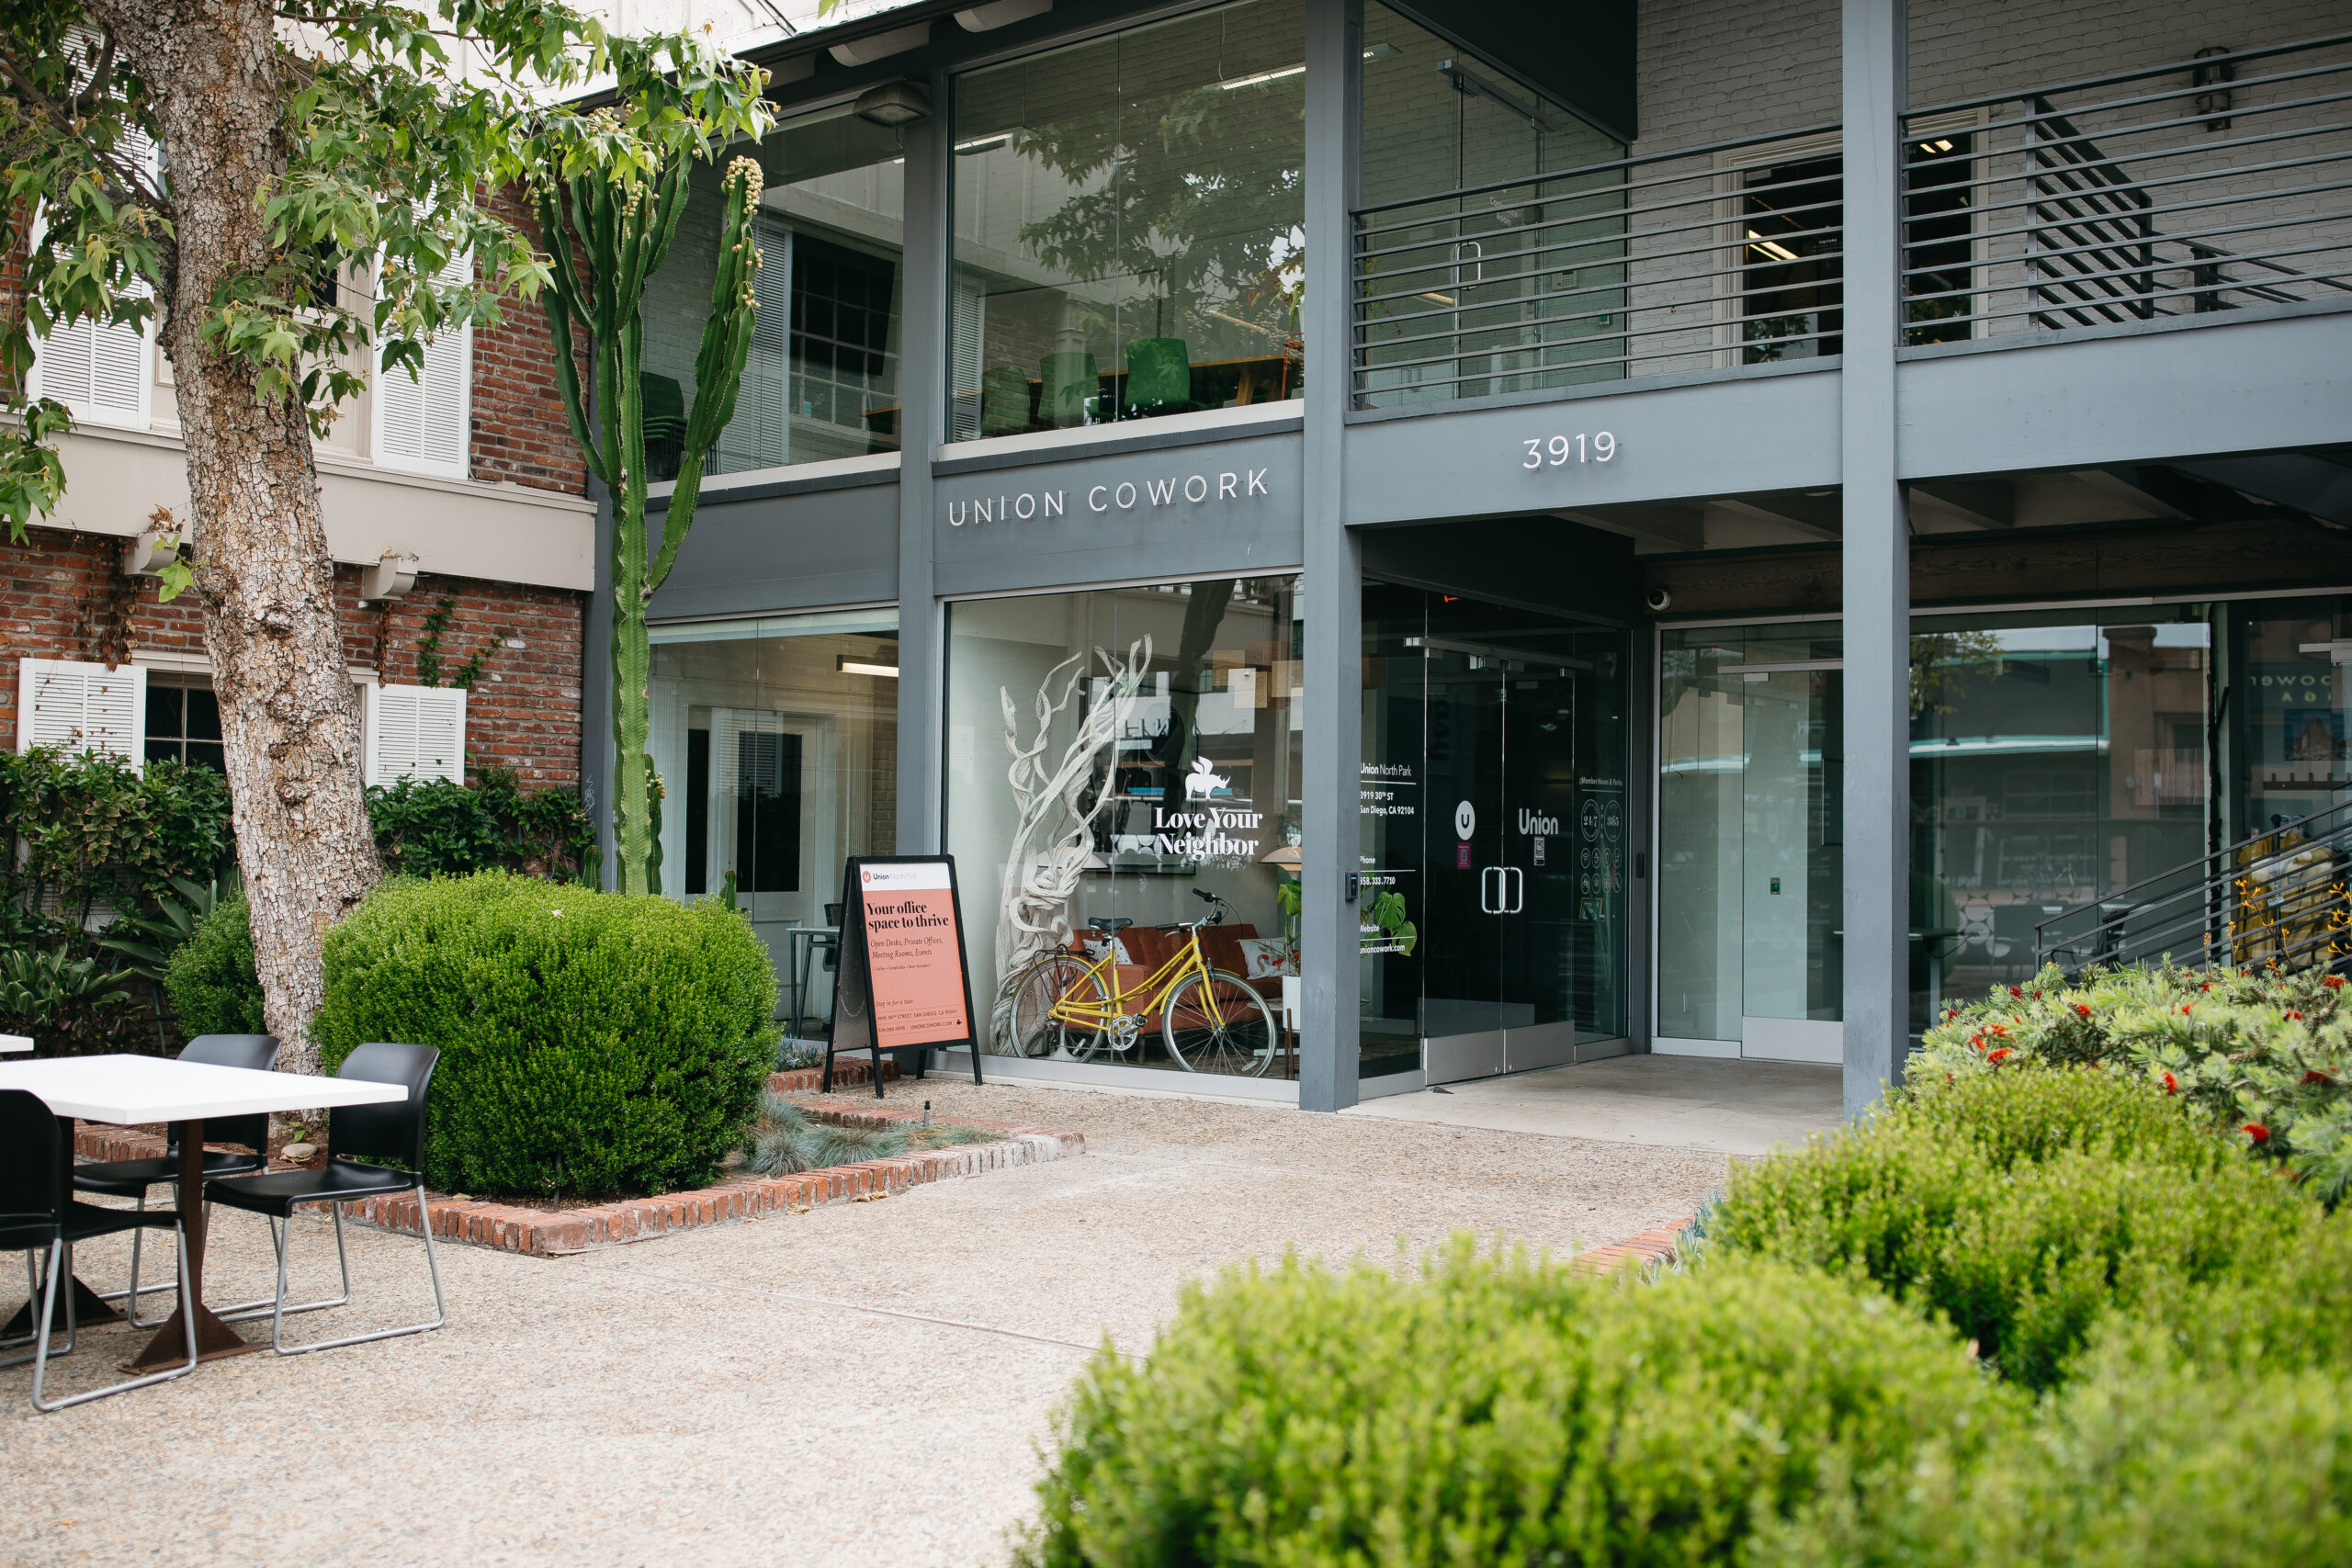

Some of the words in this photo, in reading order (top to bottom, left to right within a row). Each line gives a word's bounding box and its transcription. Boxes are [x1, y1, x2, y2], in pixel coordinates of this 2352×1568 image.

[1522, 431, 1616, 469] 3919
[948, 490, 1064, 527] UNION
[1088, 467, 1269, 513] COWORK
[1360, 761, 1379, 774] Union
[1379, 763, 1398, 776] North
[1398, 764, 1412, 777] Park
[1360, 790, 1374, 799] 3919
[1386, 792, 1395, 801] ST
[1154, 807, 1206, 829] Love
[1207, 807, 1263, 829] Your
[1360, 805, 1370, 814] San
[1370, 805, 1388, 817] Diego,
[1388, 806, 1397, 815] CA
[1396, 806, 1415, 815] 92104
[1461, 814, 1470, 829] U
[1518, 807, 1559, 835] Union
[1158, 831, 1260, 861] Neighbor
[873, 873, 890, 881] Union
[866, 902, 895, 916] Your
[897, 900, 927, 915] office
[868, 919, 899, 933] space
[902, 917, 914, 929] to
[916, 914, 949, 928] thrive
[871, 940, 885, 950] Open
[886, 938, 903, 947] Desks,
[904, 937, 923, 947] Private
[923, 936, 944, 946] Offices,
[872, 951, 894, 961] Meeting
[895, 949, 914, 958] Rooms,
[915, 948, 933, 956] Events
